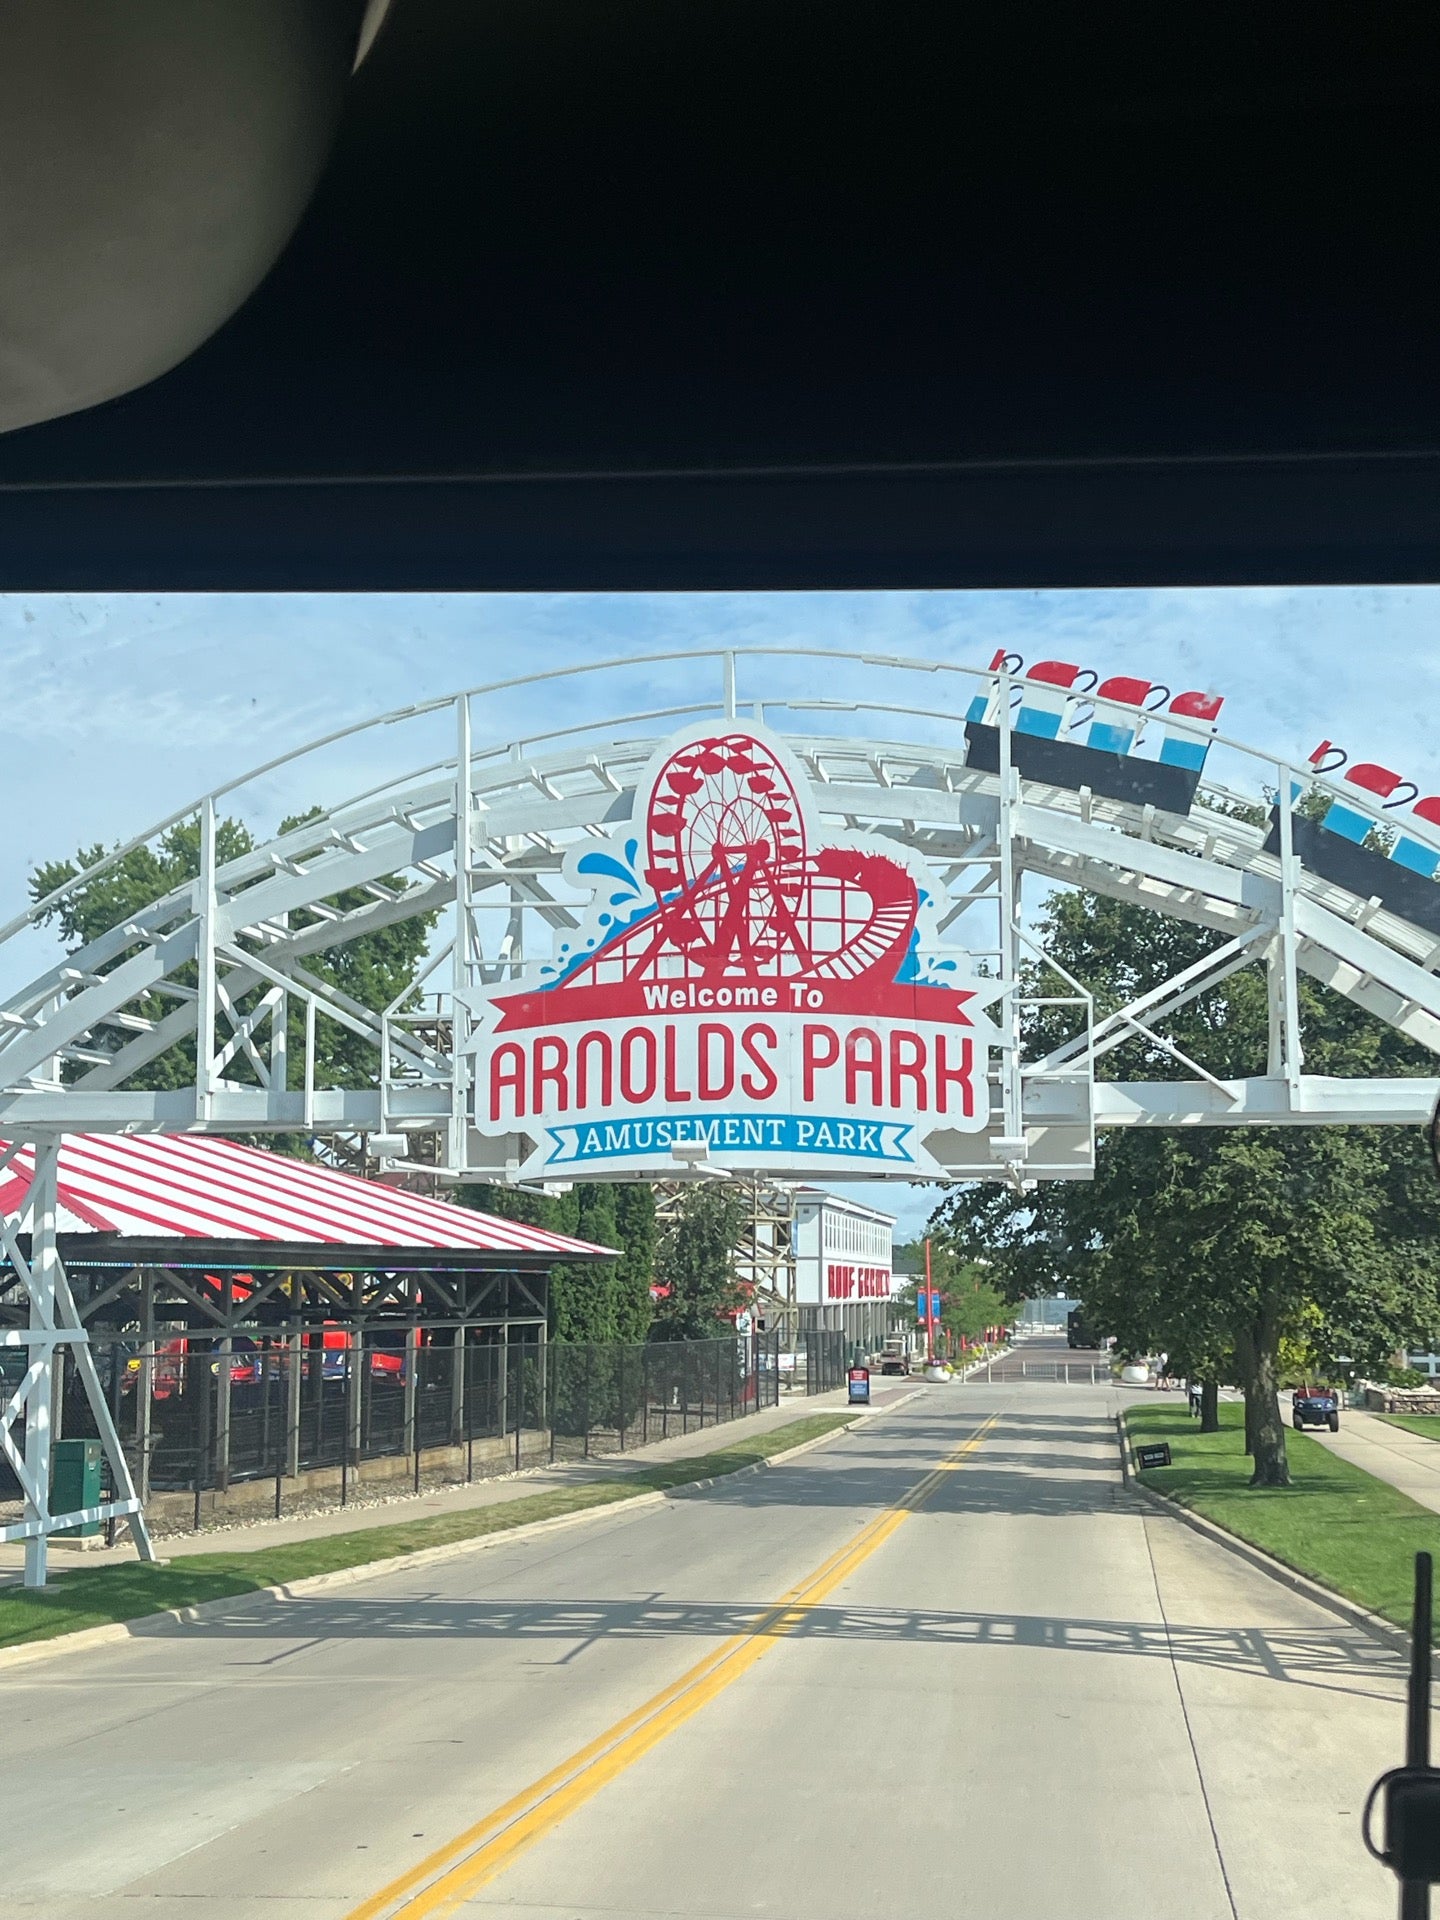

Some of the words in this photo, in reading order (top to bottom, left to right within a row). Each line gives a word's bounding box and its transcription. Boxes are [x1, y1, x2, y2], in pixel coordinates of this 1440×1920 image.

[643, 983, 778, 1010] Welcome
[789, 982, 824, 1008] To
[489, 1022, 778, 1121] ARNOLDS
[803, 1024, 973, 1117] PARK
[582, 1119, 786, 1152] AMUSEMENT
[796, 1120, 879, 1151] PARK
